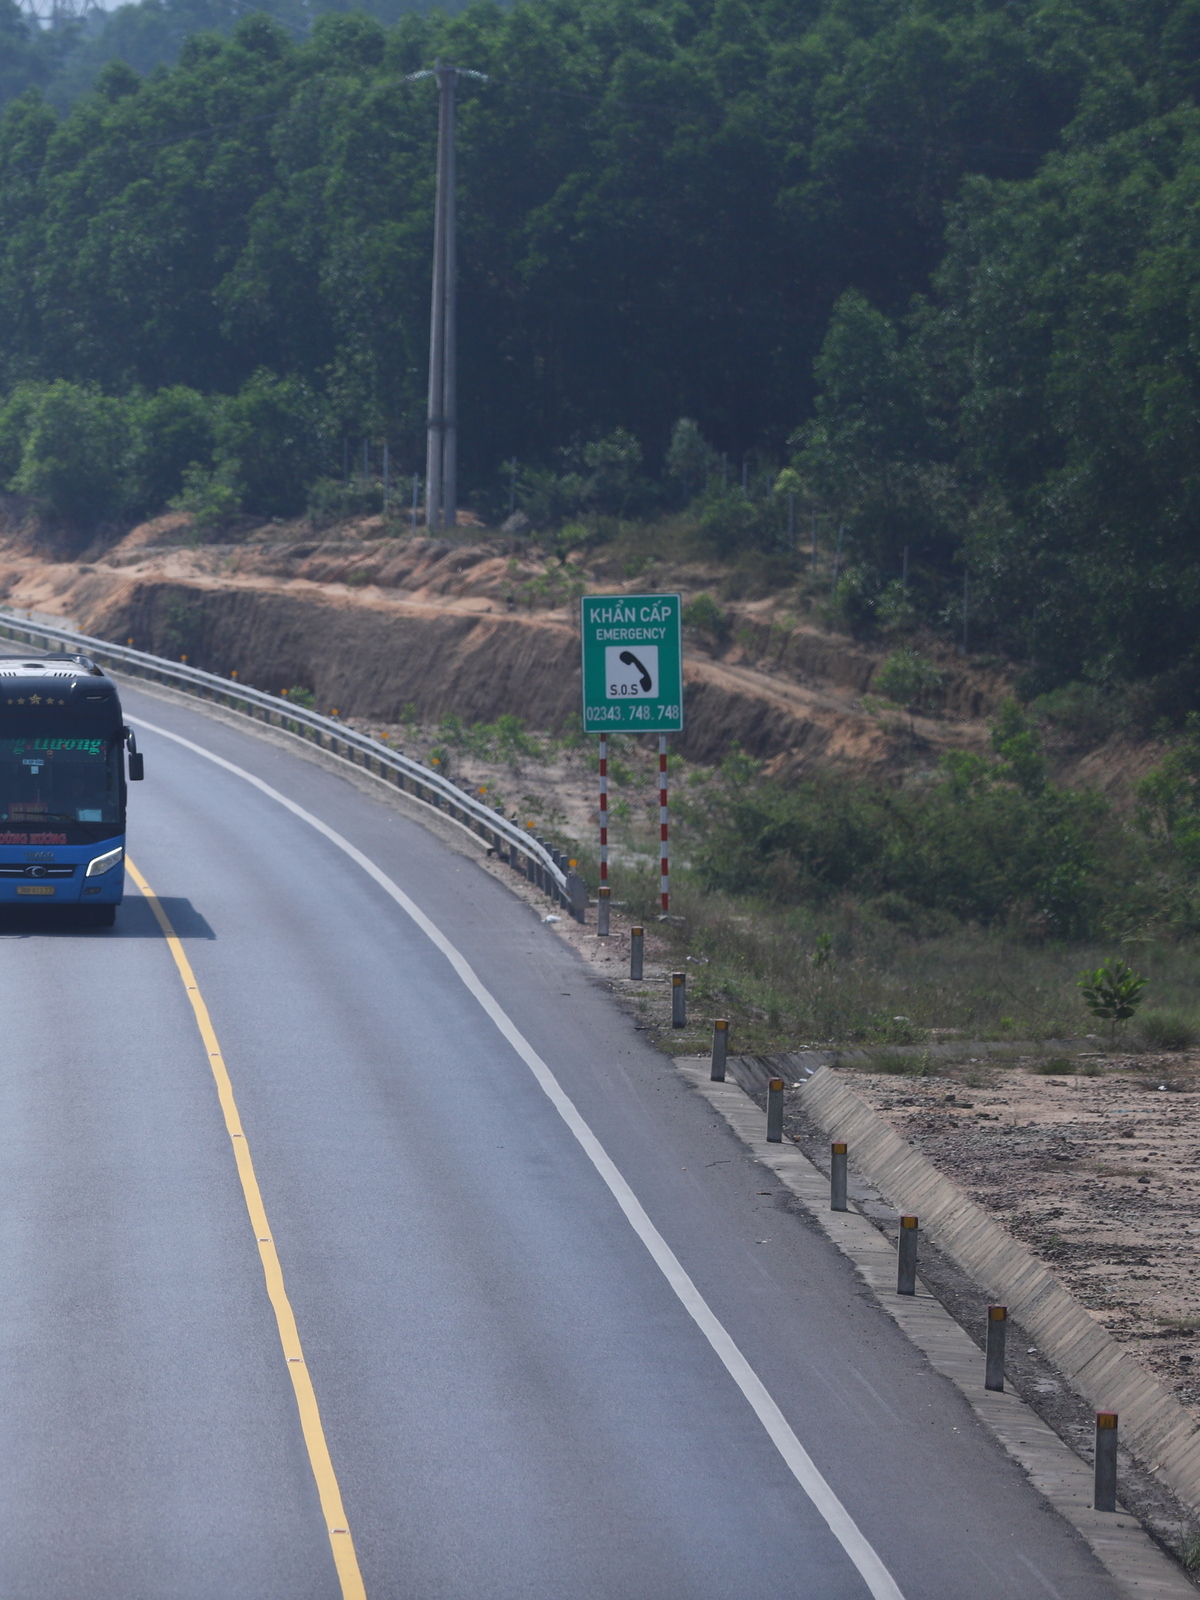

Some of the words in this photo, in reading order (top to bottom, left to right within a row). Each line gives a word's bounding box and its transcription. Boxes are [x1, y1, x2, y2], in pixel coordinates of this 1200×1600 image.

[590, 600, 636, 624] KHẨN
[640, 600, 672, 623] CẤP
[596, 627, 666, 641] EMERGENCY
[610, 684, 639, 696] S.O.S
[657, 705, 679, 720] 748
